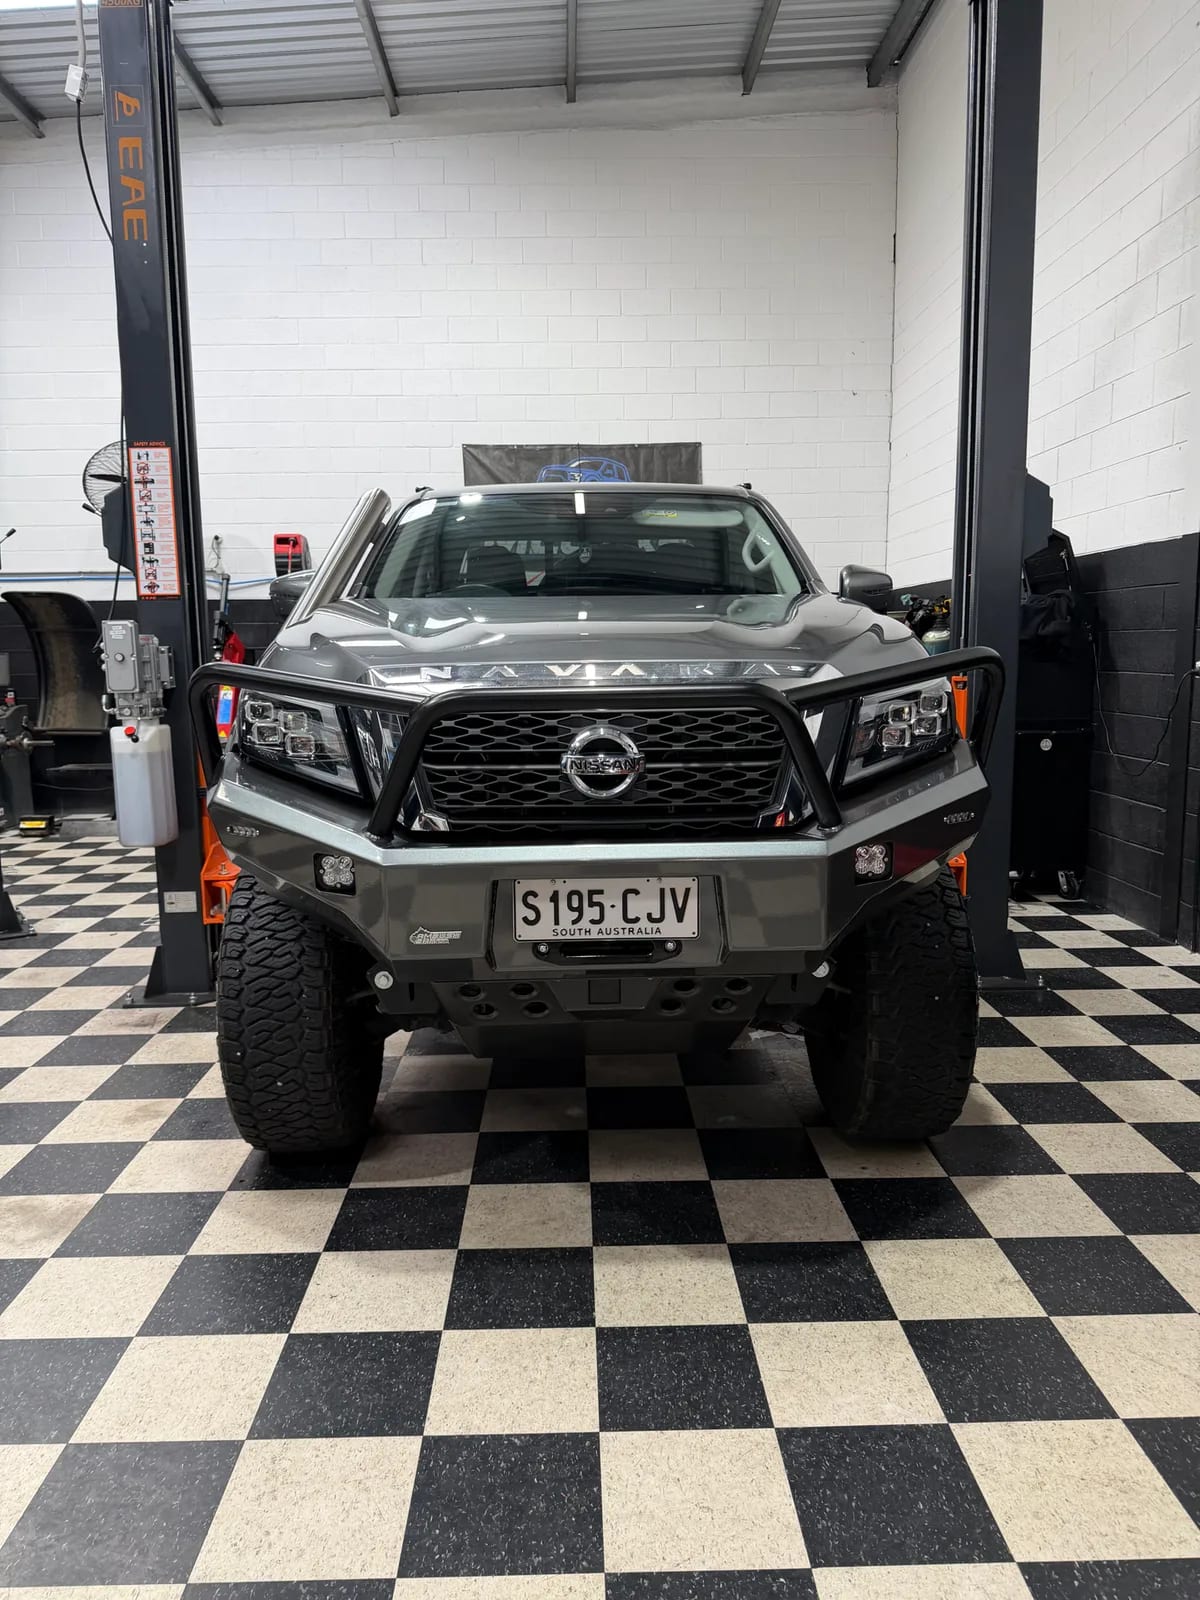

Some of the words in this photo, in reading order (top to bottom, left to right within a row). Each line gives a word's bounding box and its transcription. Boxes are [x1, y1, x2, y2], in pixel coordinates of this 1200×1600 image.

[420, 663, 781, 680] NAVARA
[570, 757, 636, 773] NISSAN
[552, 927, 591, 937] SOUTH
[597, 926, 662, 936] AUSTRALIA
